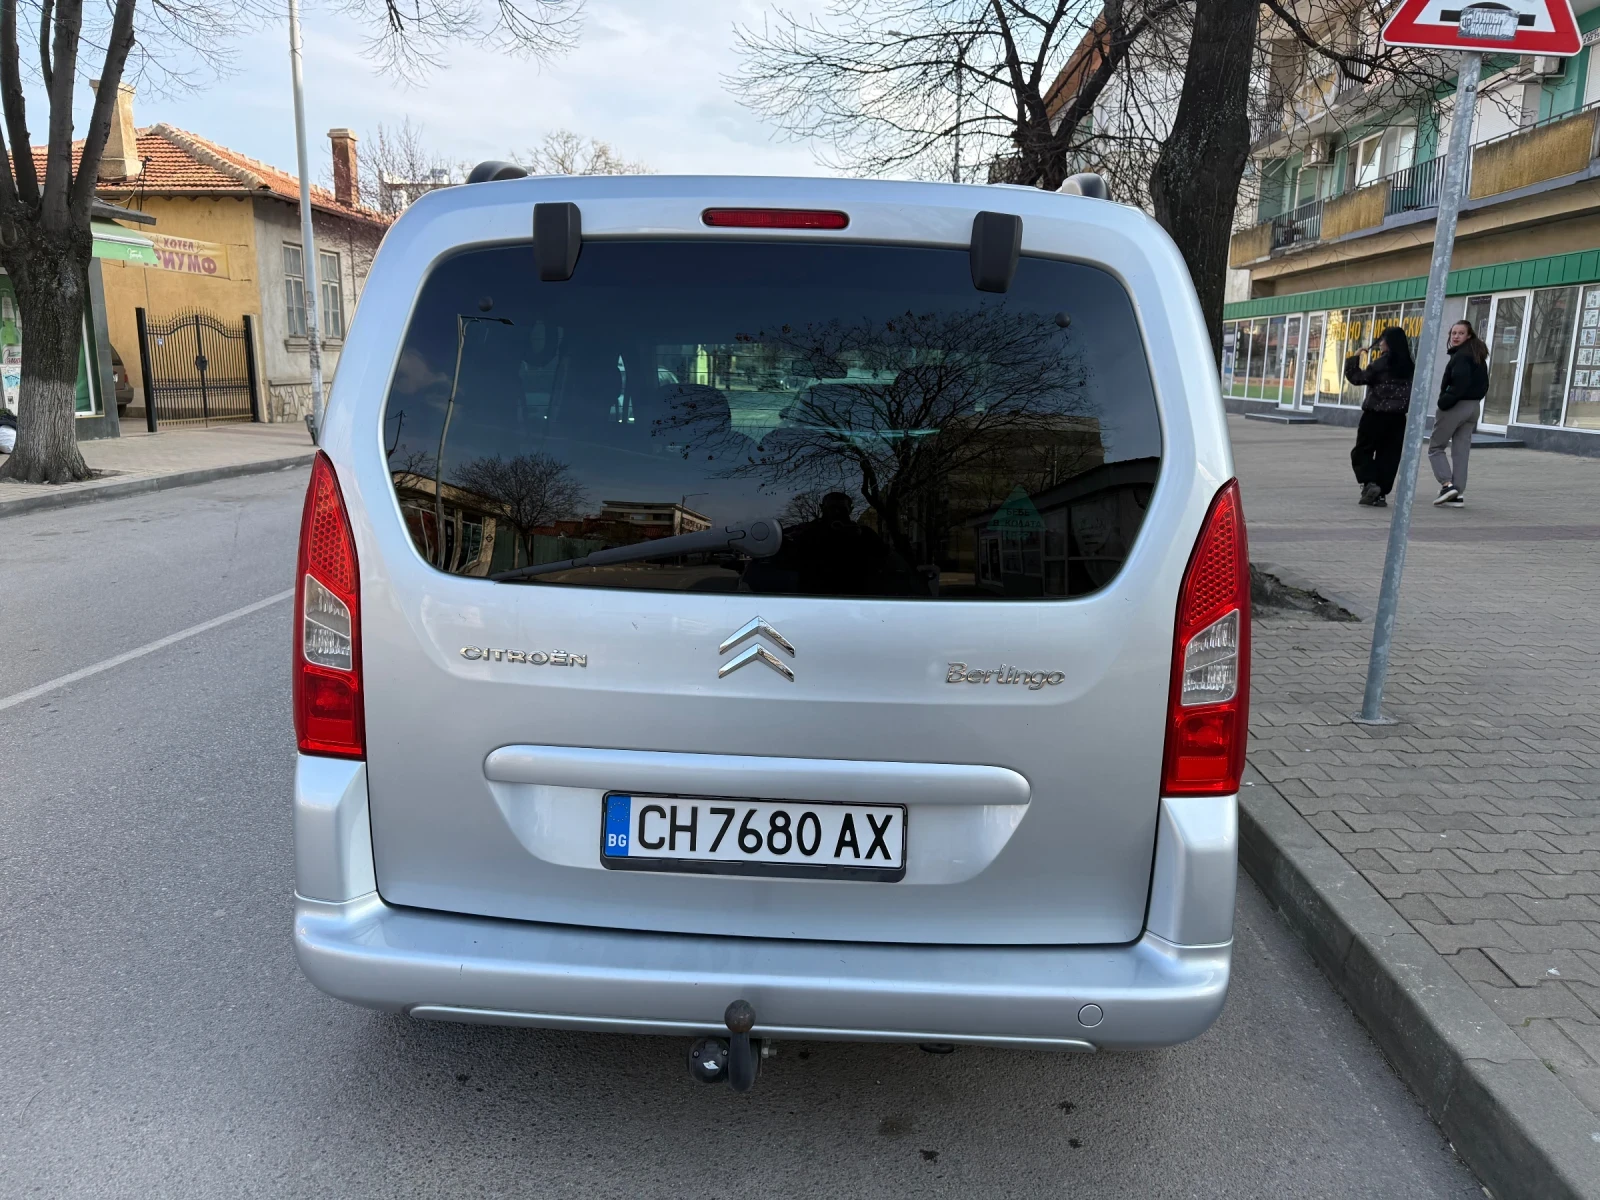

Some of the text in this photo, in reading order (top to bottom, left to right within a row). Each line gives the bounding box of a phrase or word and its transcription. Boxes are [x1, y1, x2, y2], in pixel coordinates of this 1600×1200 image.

[163, 237, 194, 252] ХОТЕЛ
[144, 248, 217, 274] РИУМФ
[1006, 508, 1030, 517] БЕБЕ
[993, 519, 1042, 528] В КОЛАТА
[459, 644, 588, 668] CITROËN
[946, 661, 1066, 691] Berlingo
[607, 833, 627, 848] BG
